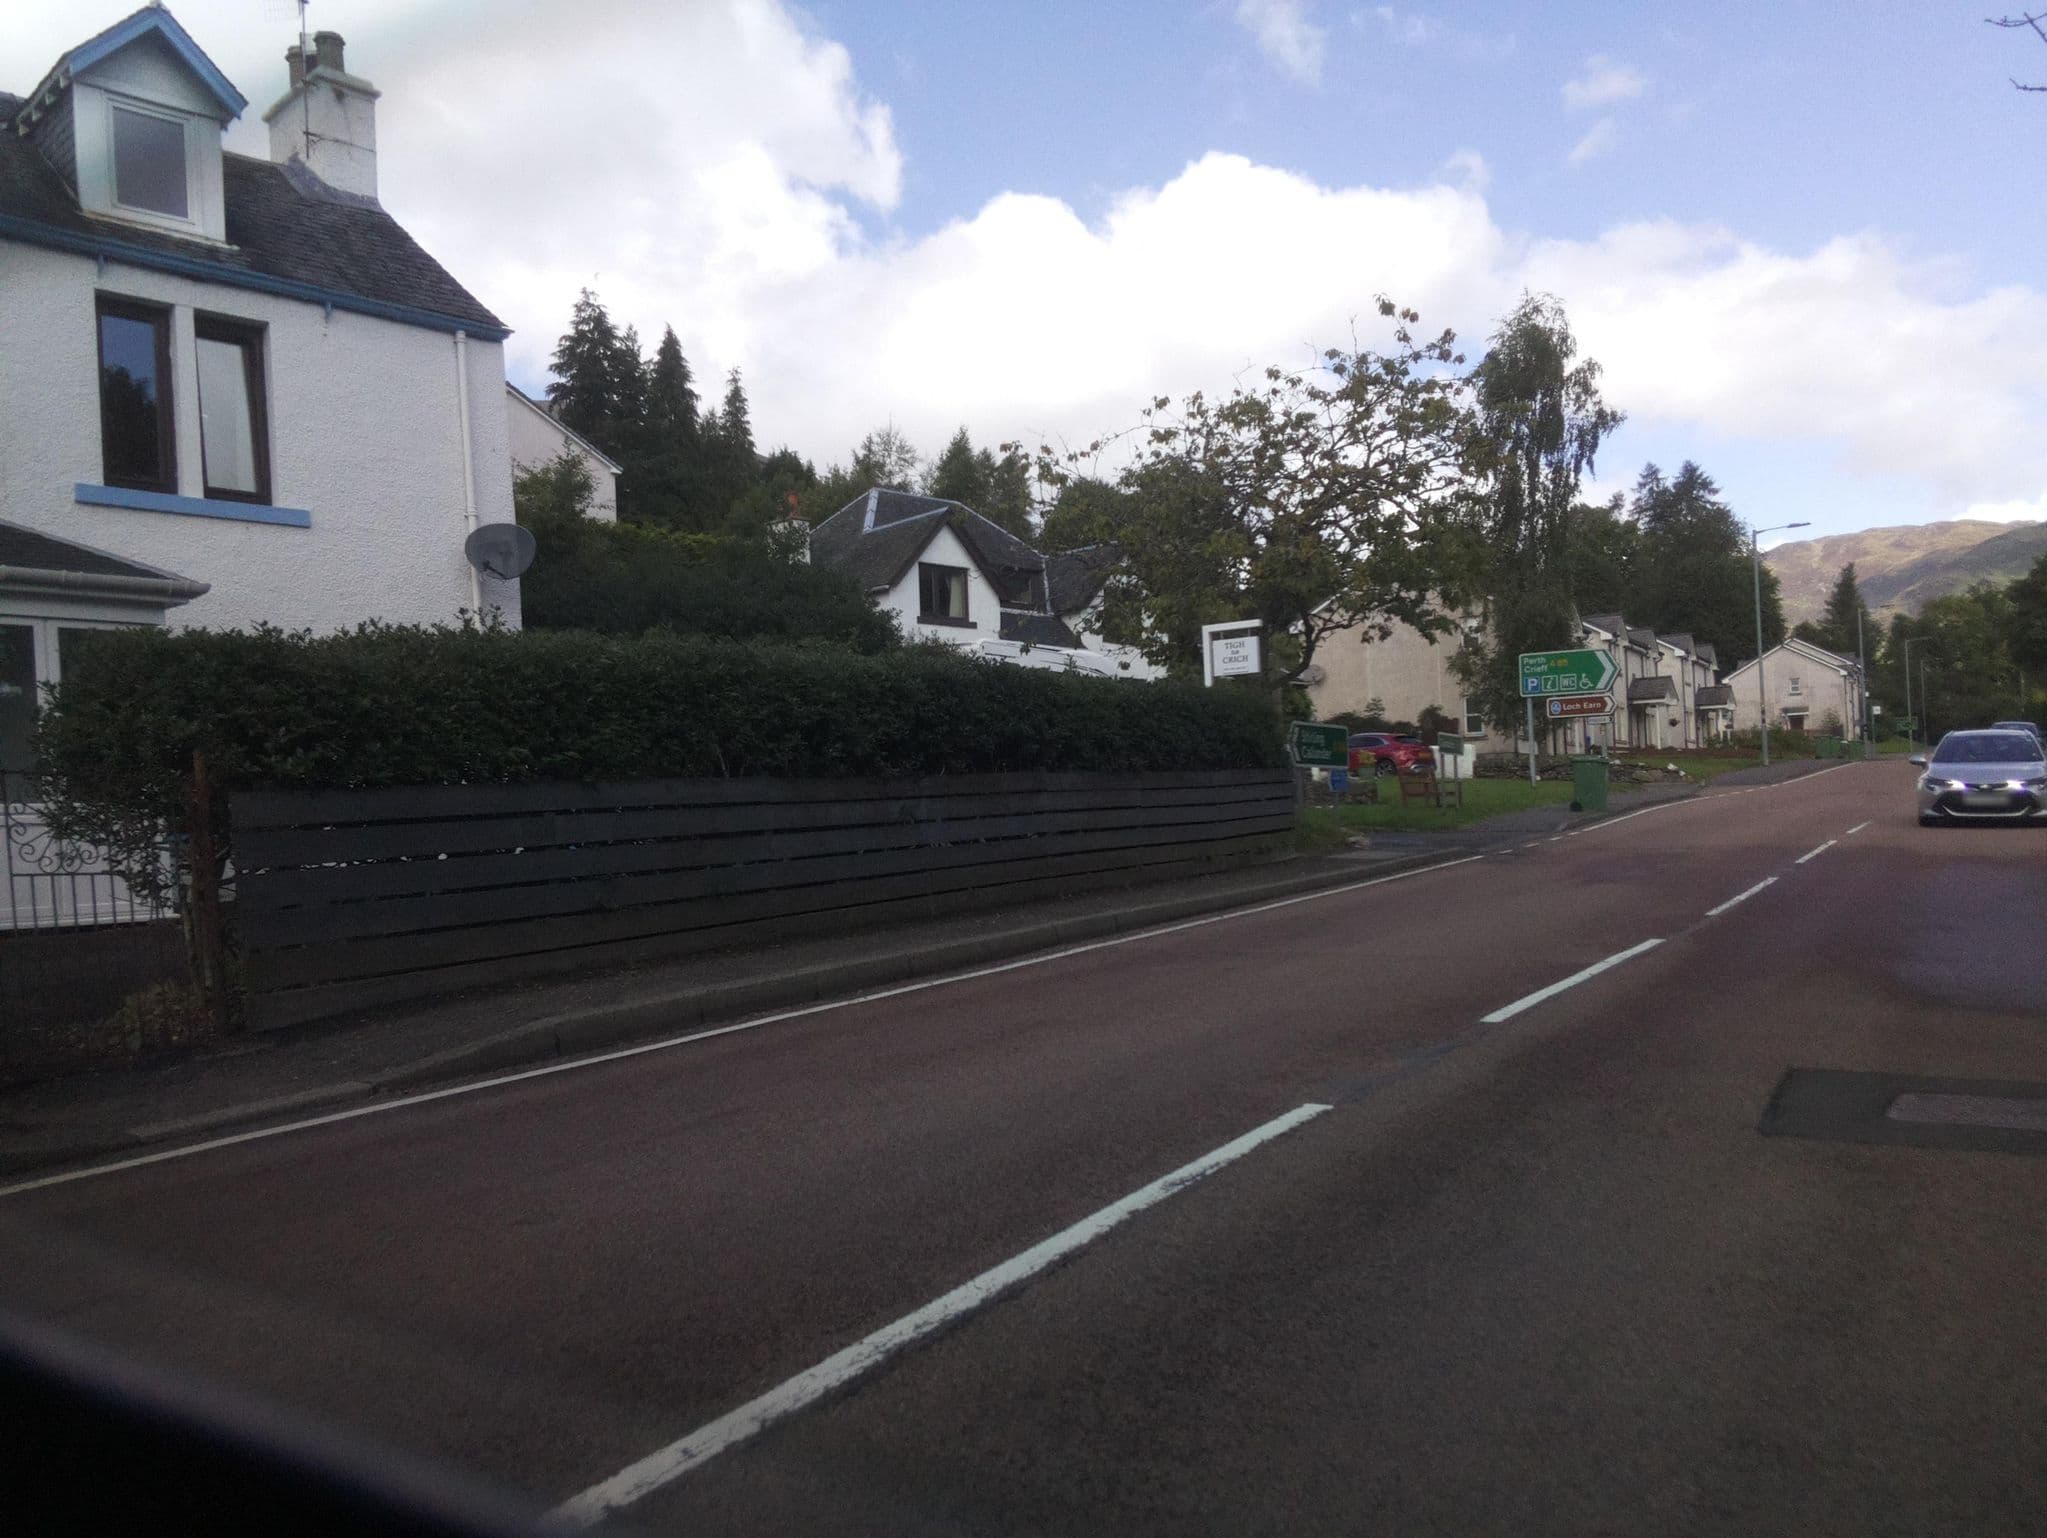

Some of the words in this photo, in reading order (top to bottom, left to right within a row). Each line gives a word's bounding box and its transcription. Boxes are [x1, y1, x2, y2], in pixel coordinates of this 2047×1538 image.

[1224, 641, 1246, 650] TIGH
[1222, 655, 1249, 664] CRICH
[1523, 656, 1547, 665] Perth
[1523, 664, 1549, 673] Crieff
[1527, 678, 1539, 691] P
[1561, 676, 1576, 689] WC
[1562, 702, 1581, 711] Loch
[1583, 701, 1602, 709] Earn
